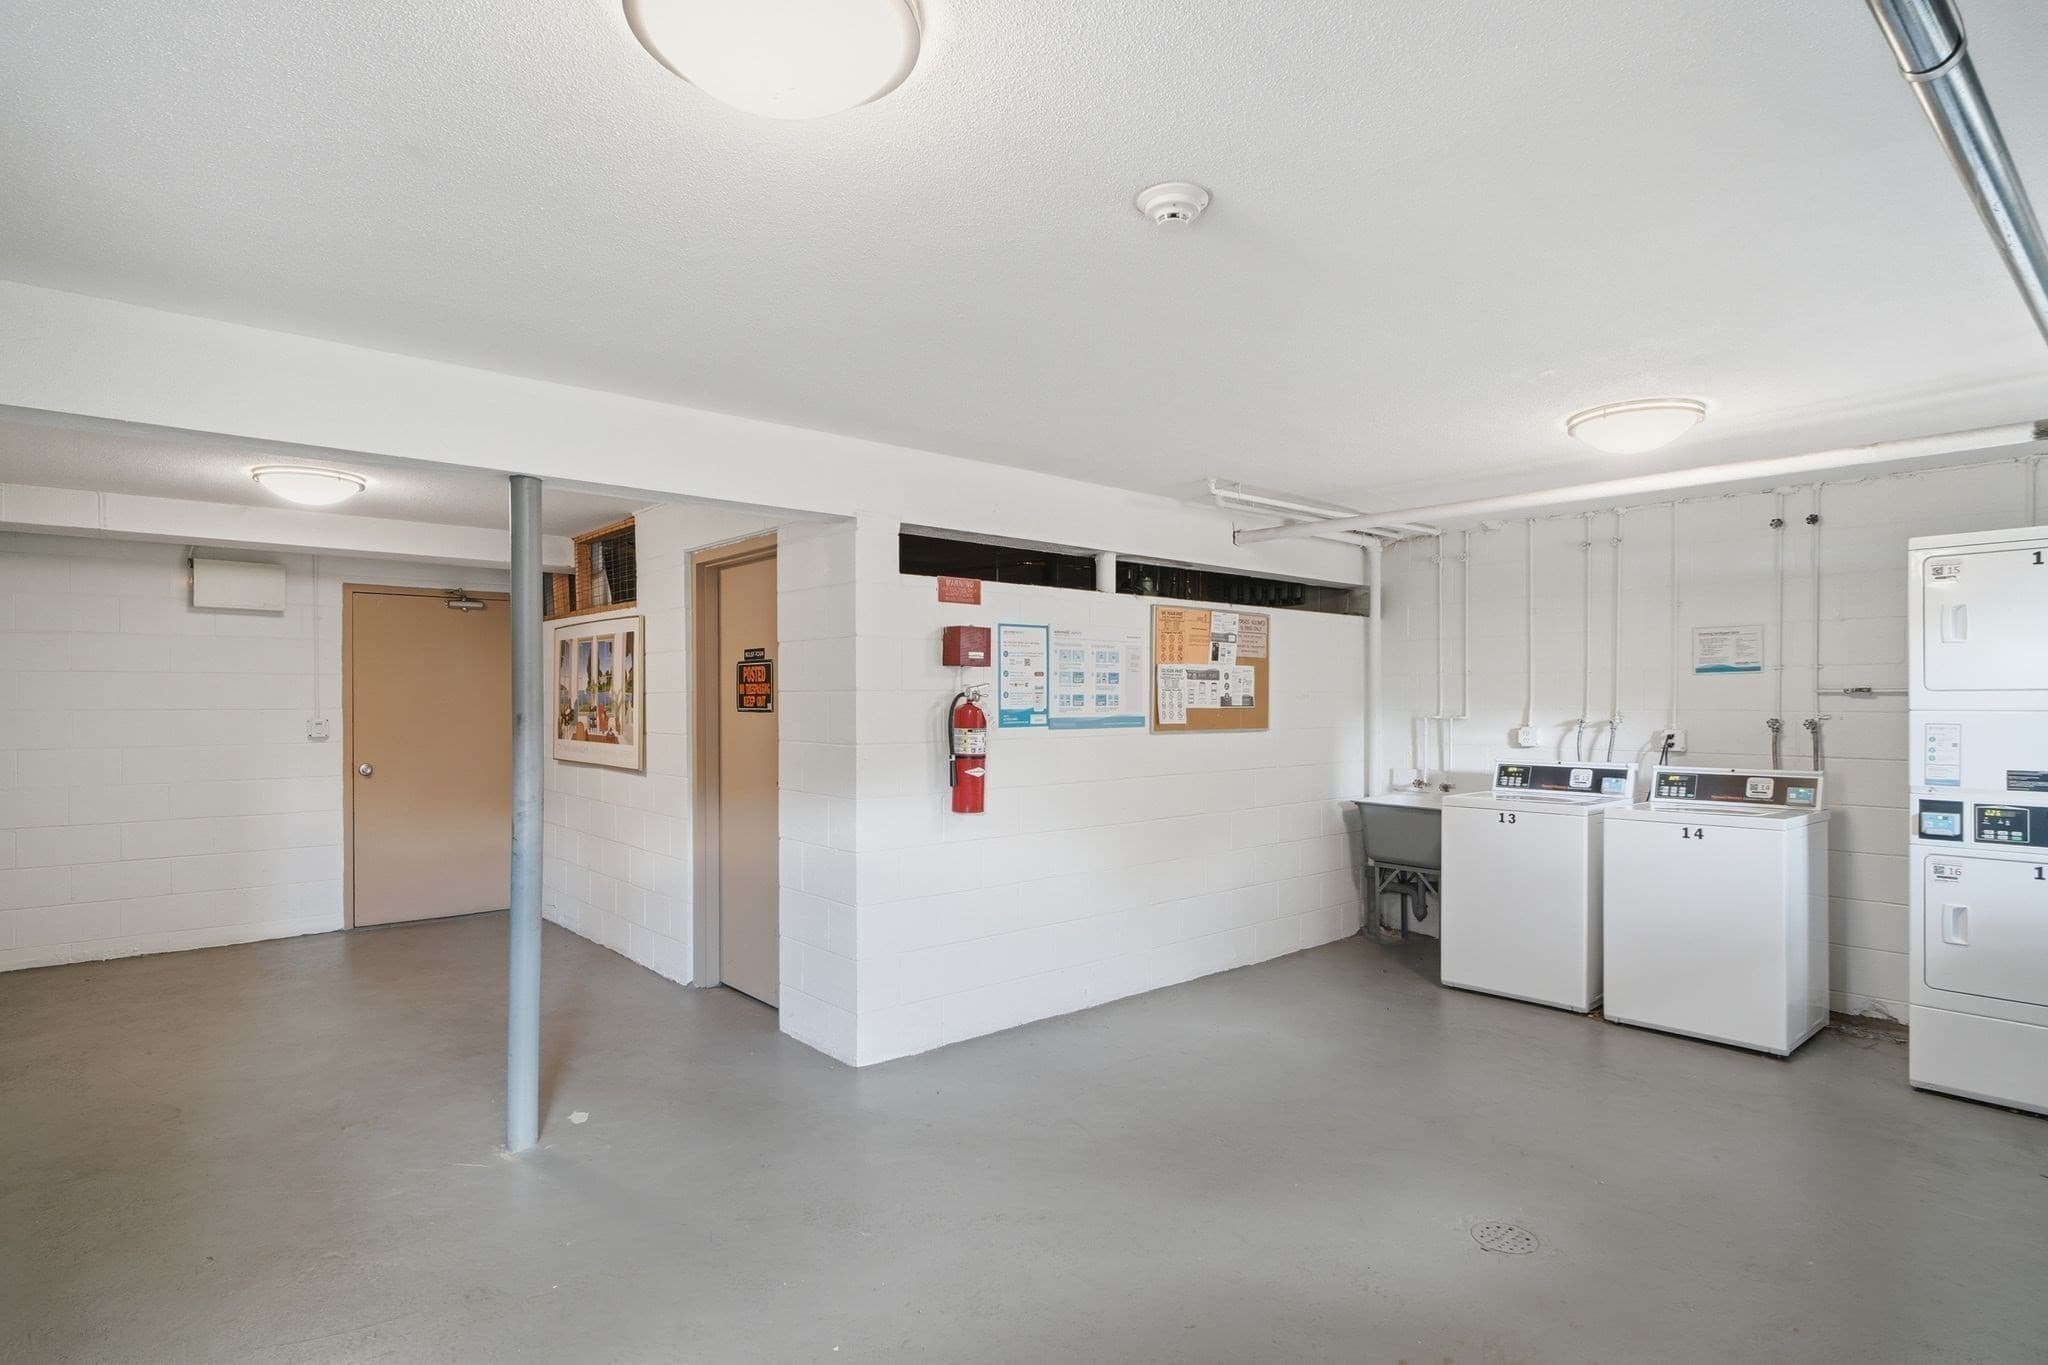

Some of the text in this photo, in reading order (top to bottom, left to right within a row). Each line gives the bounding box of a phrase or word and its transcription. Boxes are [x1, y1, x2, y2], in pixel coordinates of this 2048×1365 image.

[743, 665, 766, 683] POSTED
[743, 695, 766, 707] KEEP OUT
[1498, 813, 1516, 824] 13
[1681, 827, 1705, 840] 14
